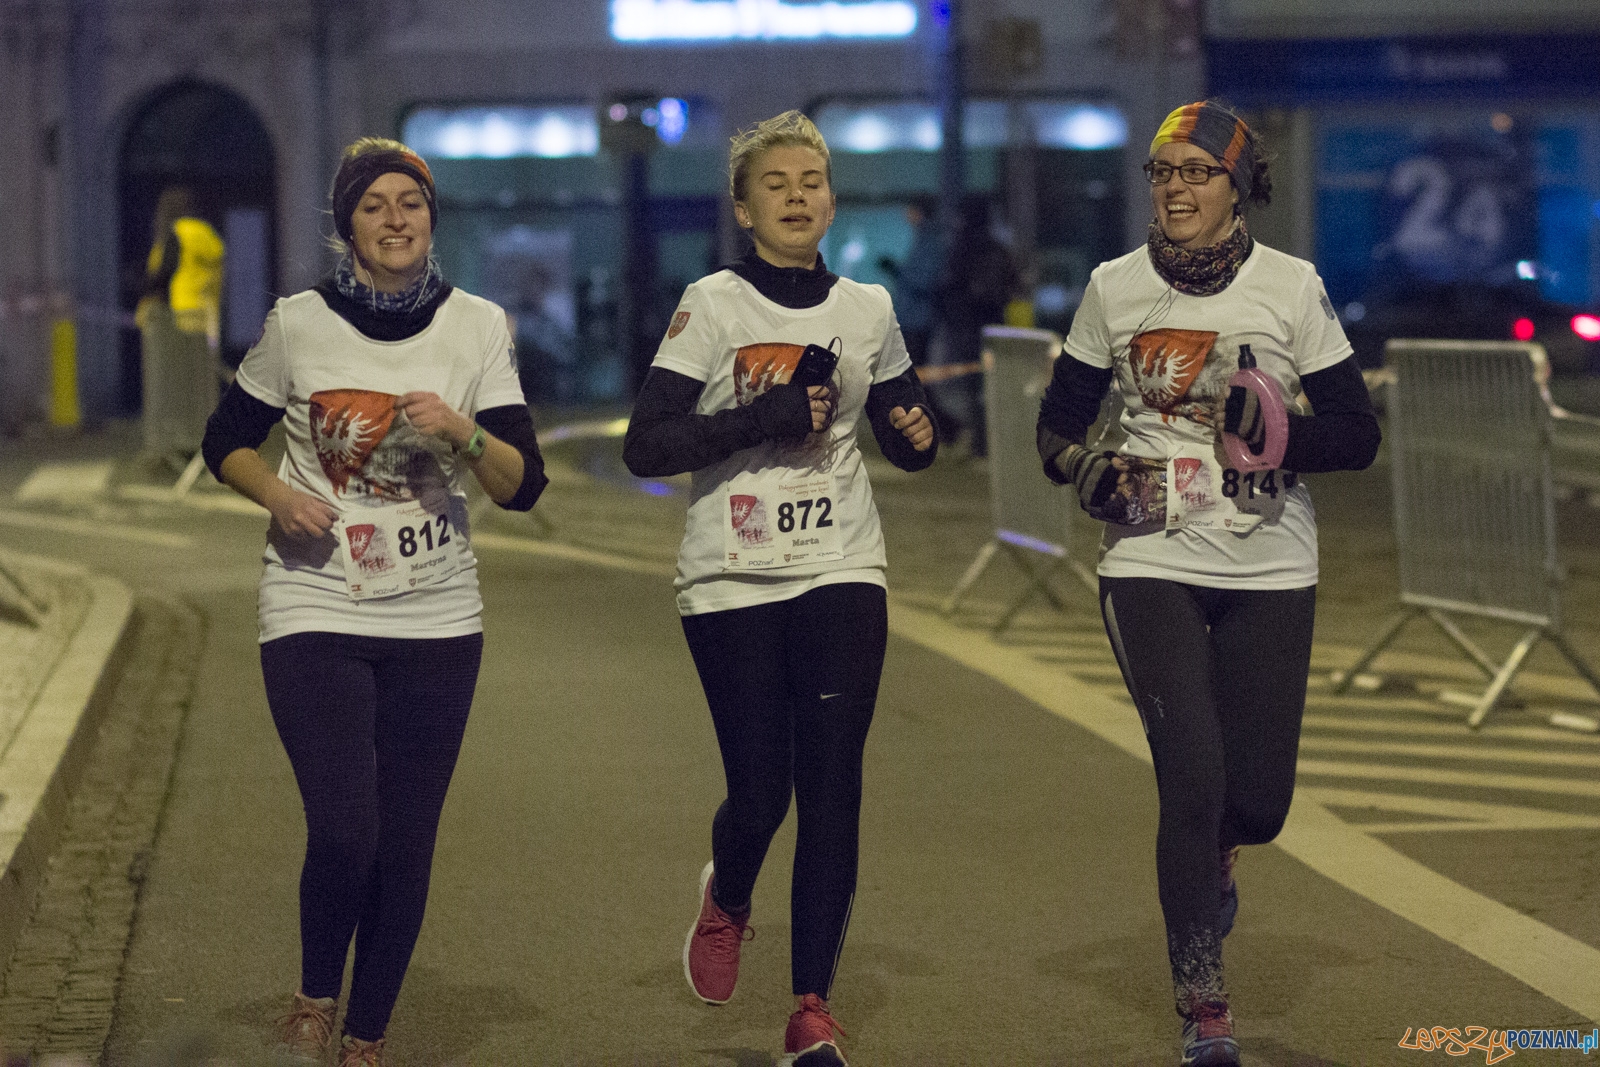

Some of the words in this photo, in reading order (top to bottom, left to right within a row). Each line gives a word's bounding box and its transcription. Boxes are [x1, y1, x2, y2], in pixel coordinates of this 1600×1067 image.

[1221, 467, 1278, 499] 814
[777, 496, 833, 533] 872
[398, 514, 451, 558] 812
[792, 538, 819, 547] Marta
[410, 555, 447, 573] Martyna
